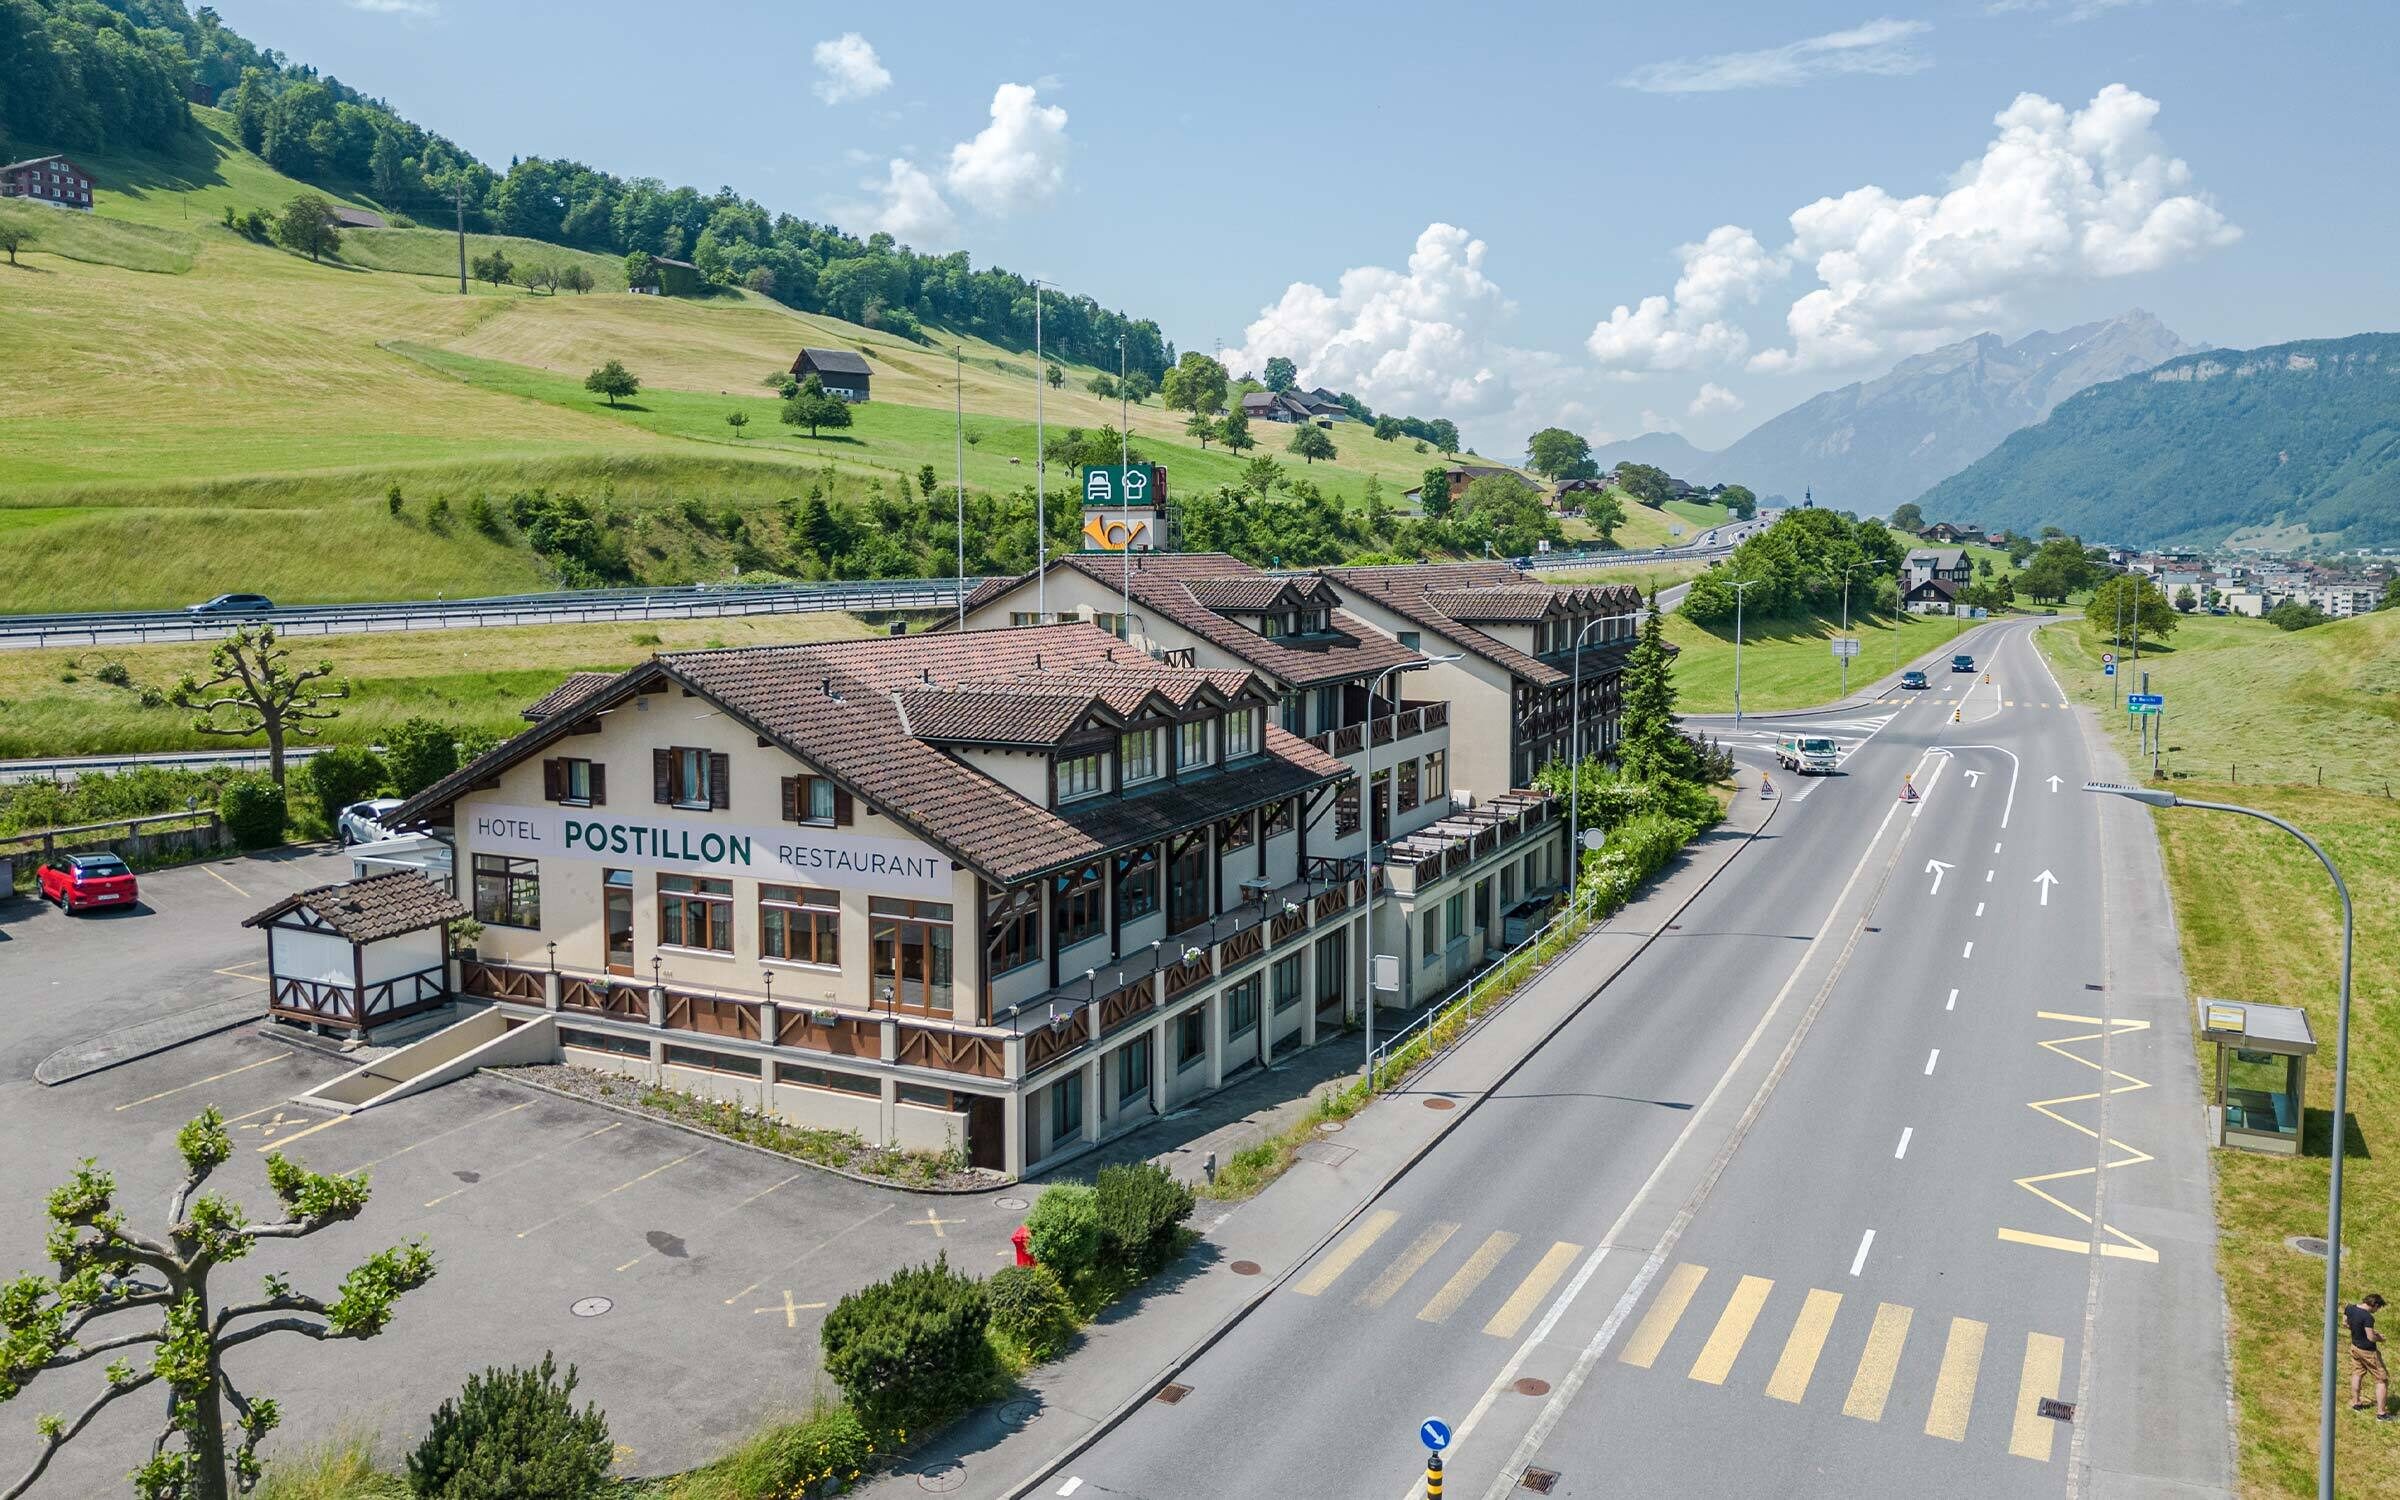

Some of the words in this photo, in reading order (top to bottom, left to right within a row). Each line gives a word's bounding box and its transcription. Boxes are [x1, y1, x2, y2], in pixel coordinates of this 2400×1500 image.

[478, 817, 541, 841] HOTEL
[565, 820, 751, 866] POSTILLON
[779, 845, 939, 878] RESTAURANT
